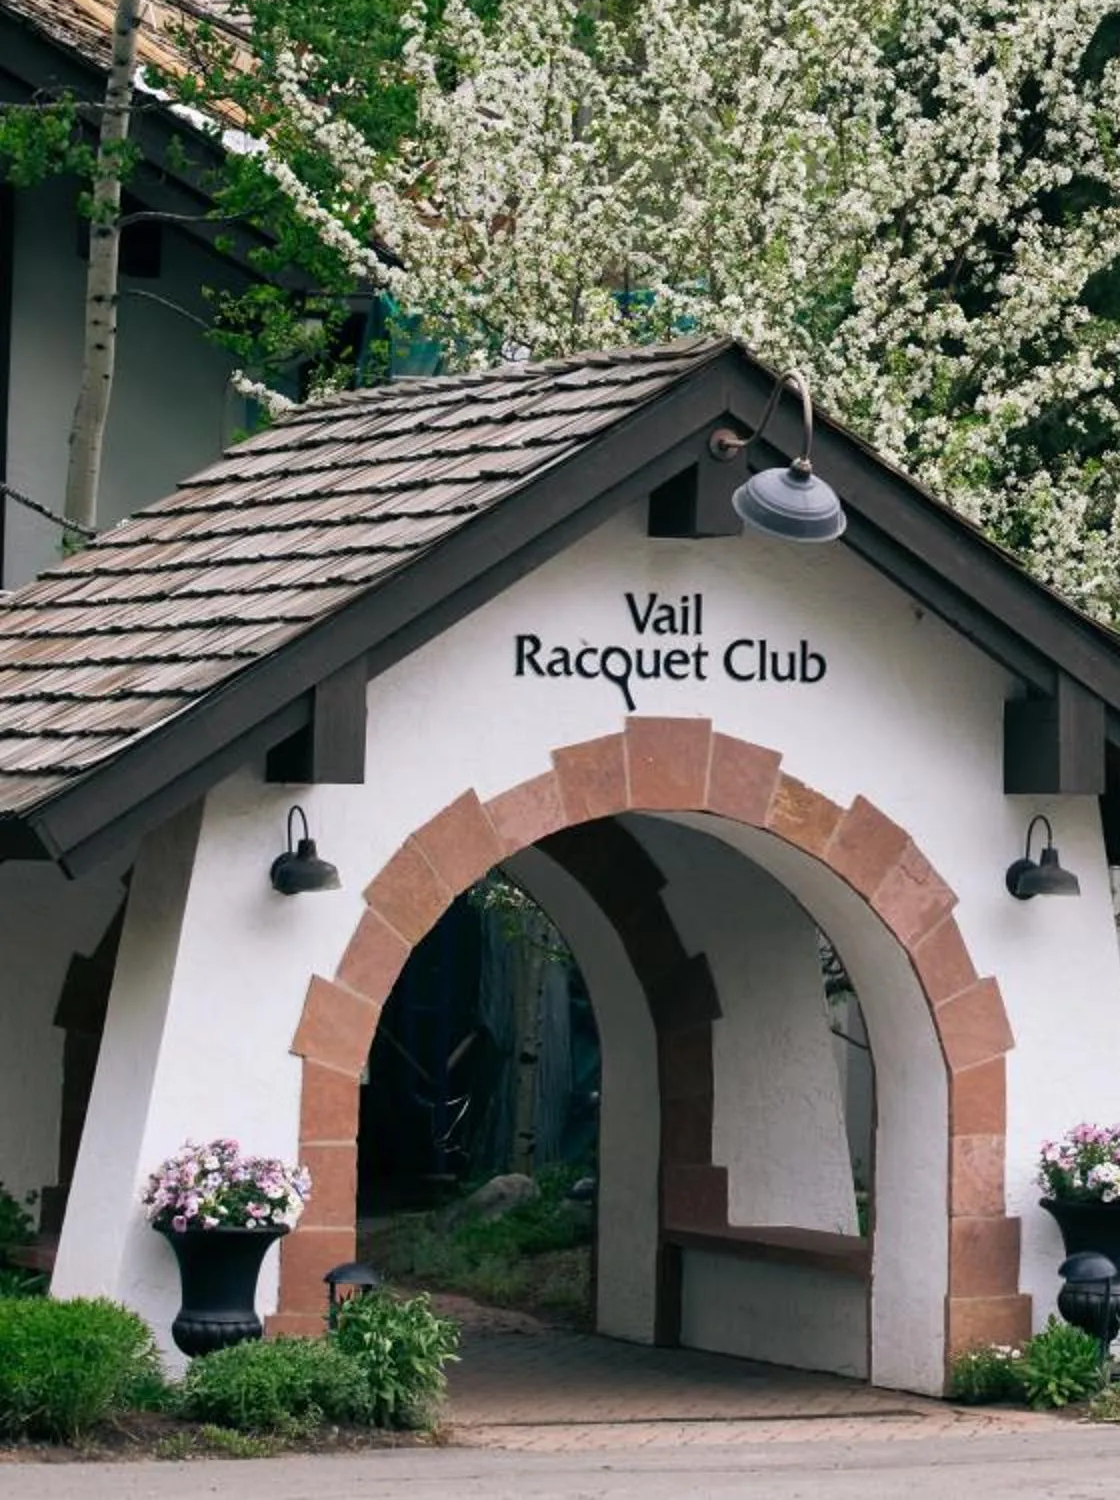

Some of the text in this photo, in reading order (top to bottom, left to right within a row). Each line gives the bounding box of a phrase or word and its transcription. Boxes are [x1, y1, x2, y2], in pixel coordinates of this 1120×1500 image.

[623, 591, 704, 636] Vail
[514, 633, 828, 712] Racquet Club
